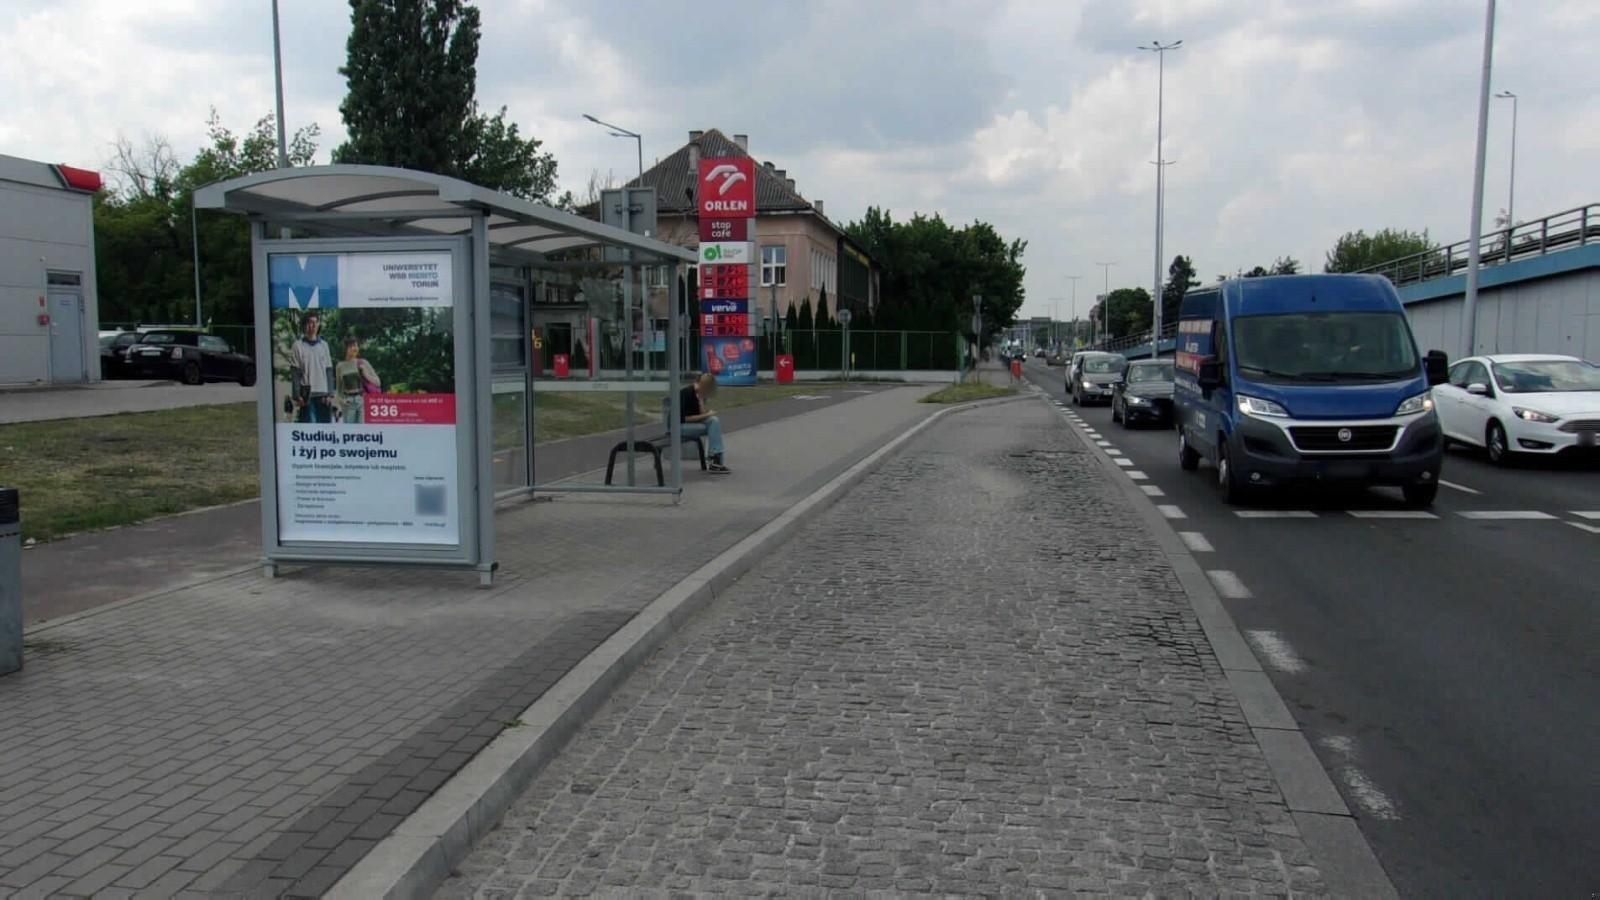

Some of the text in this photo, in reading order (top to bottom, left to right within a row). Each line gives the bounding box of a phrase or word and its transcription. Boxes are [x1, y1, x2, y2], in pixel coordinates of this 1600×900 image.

[704, 200, 748, 211] ORLEN
[711, 221, 731, 230] stop
[382, 263, 438, 271] UNIWERSYTET
[389, 272, 407, 280] WSB
[711, 303, 737, 312] verva
[370, 404, 398, 417] 336
[291, 430, 383, 445] Studiuj, pracuj
[292, 446, 398, 461] i żyj po swojemu
